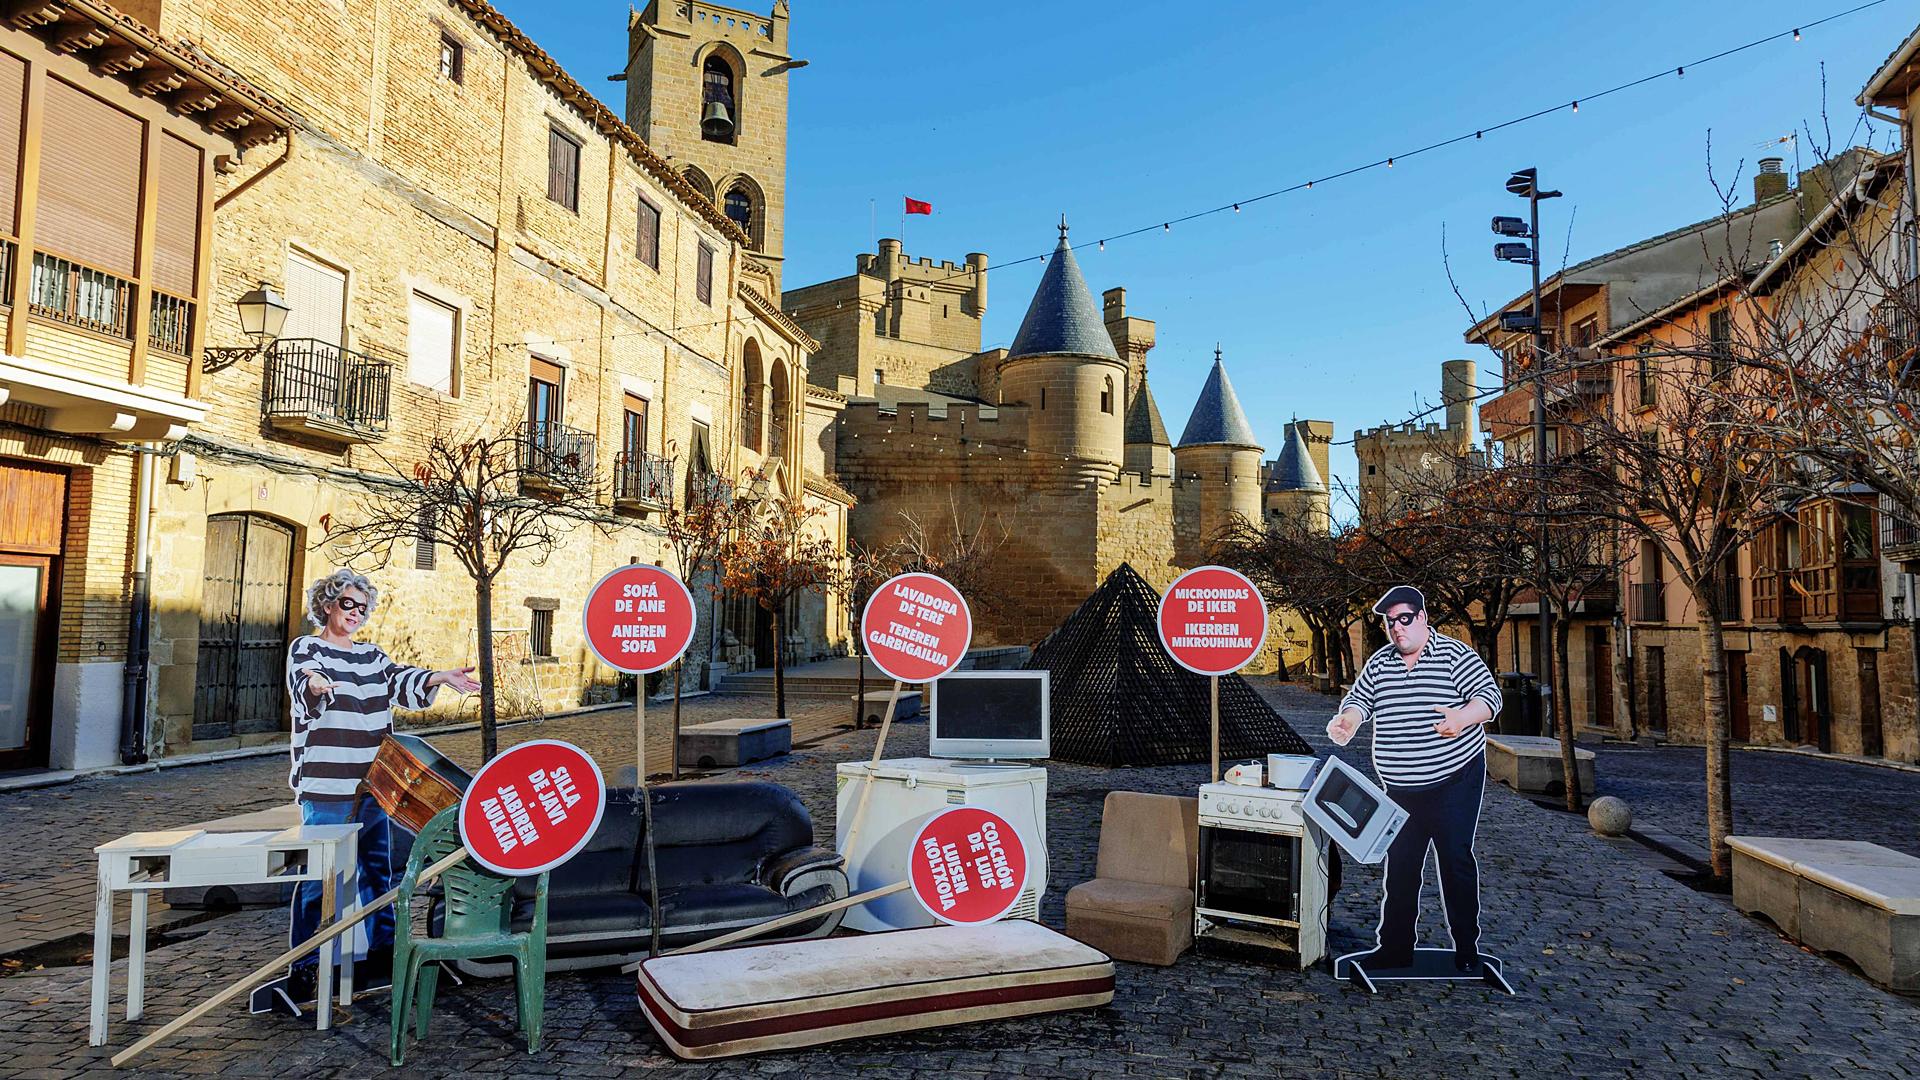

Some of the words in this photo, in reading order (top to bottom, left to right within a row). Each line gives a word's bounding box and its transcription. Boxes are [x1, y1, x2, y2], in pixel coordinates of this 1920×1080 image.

[623, 582, 658, 598] SOFÁ
[893, 584, 958, 616] LAVADORA
[1175, 588, 1249, 600] MICROONDAS
[615, 600, 633, 613] DE
[638, 600, 666, 613] ANE
[899, 601, 916, 616] DE
[916, 605, 944, 626] TERE
[1187, 601, 1204, 613] DE
[1206, 601, 1237, 613] IKER
[612, 625, 666, 638] ANEREN
[889, 621, 939, 649] TEREREN
[1184, 623, 1239, 635] IKERREN
[621, 640, 656, 653] SOFA
[869, 630, 948, 667] GARBIGAILUA
[1171, 637, 1253, 648] MIKROUHINAK
[527, 768, 550, 793] DE
[550, 766, 581, 809] SILLA
[497, 784, 540, 847] JABIREN
[538, 791, 568, 826] JAVI
[480, 797, 518, 855] AULKIA
[967, 831, 985, 853] DE
[942, 843, 969, 894] LUISEN
[981, 821, 1015, 890] COLCHÓN
[922, 837, 956, 912] KOLTXOIA
[974, 855, 997, 889] LUIS
